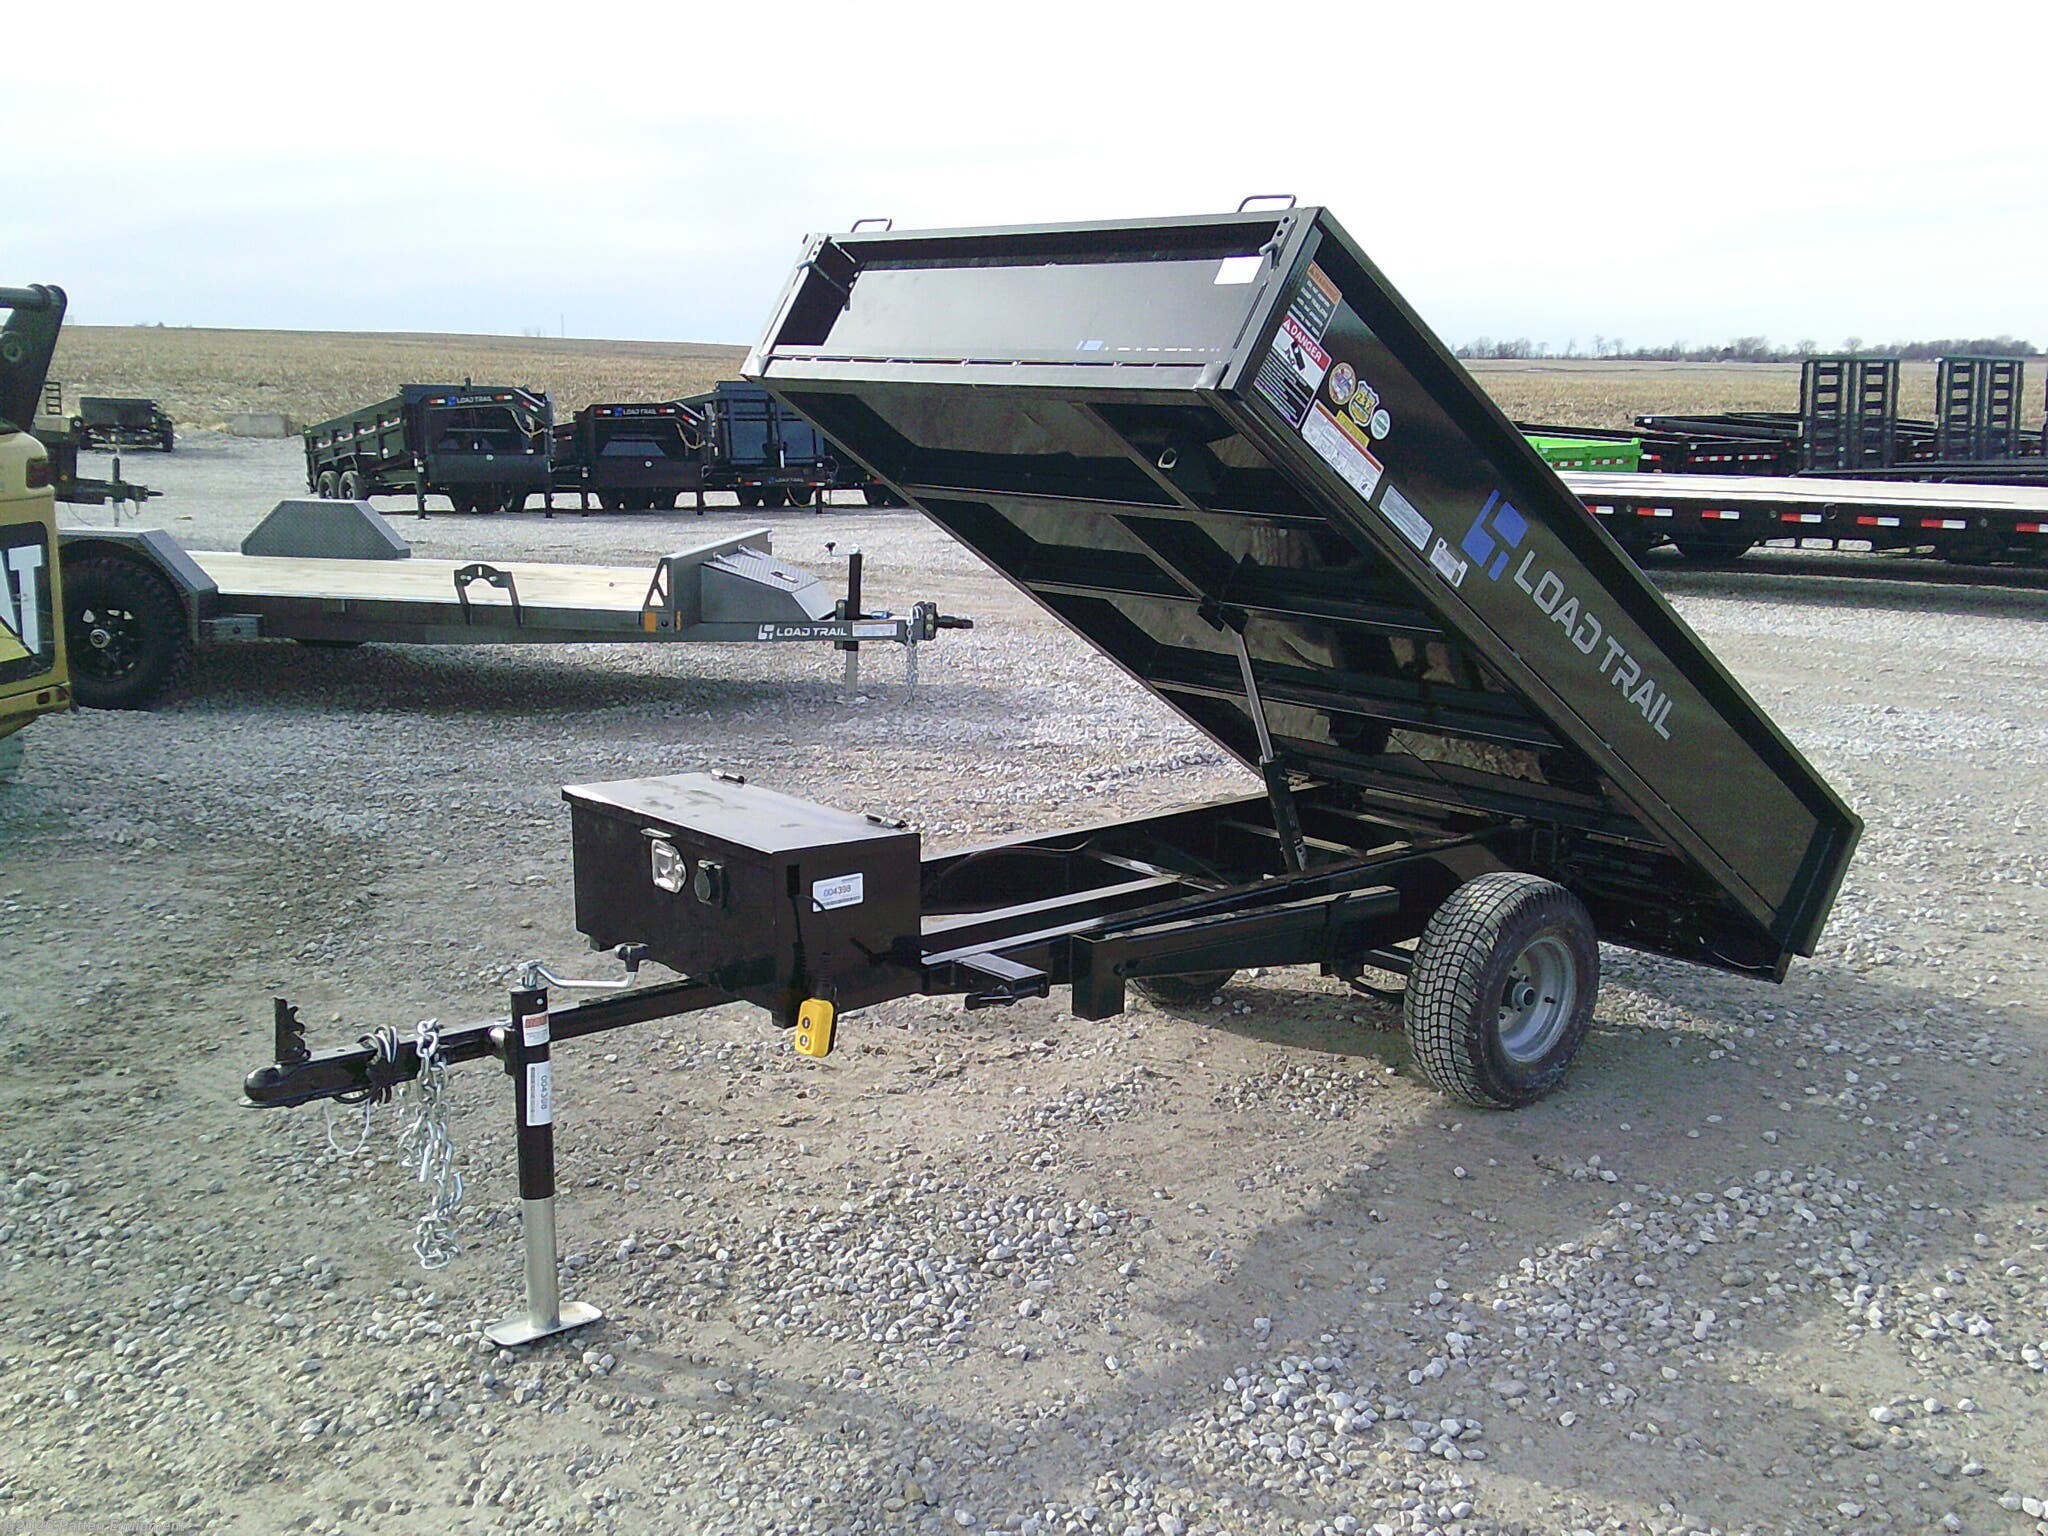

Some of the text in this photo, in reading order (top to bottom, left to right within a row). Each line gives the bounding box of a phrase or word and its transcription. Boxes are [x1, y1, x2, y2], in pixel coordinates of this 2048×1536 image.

[1289, 326, 1323, 363] DANGER
[776, 627, 811, 637] LOAD
[813, 627, 848, 636] TRAIL
[1513, 550, 1673, 740] LOAD TRAIL
